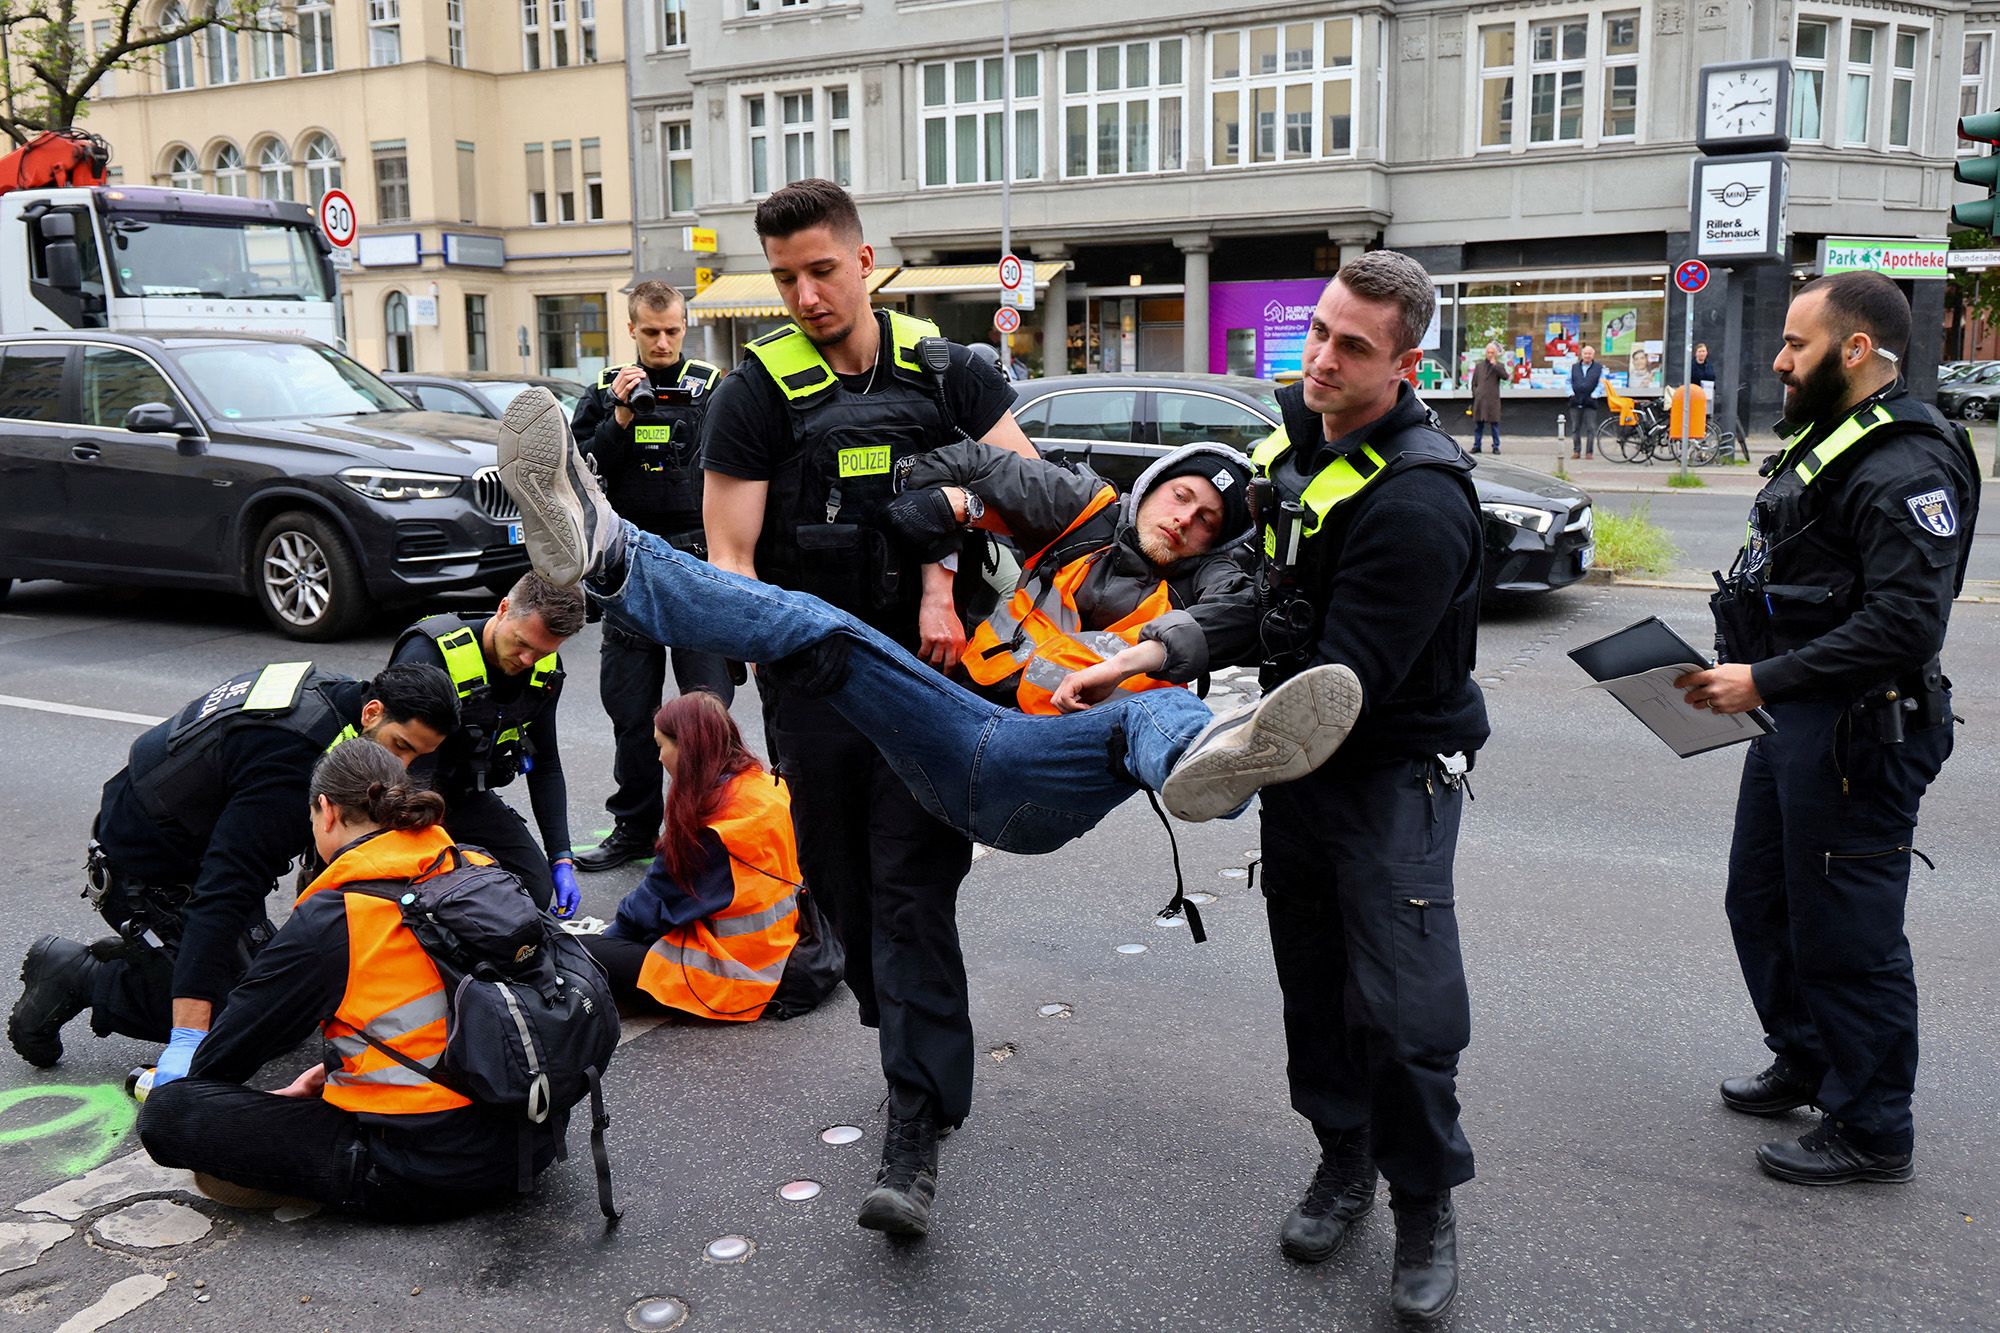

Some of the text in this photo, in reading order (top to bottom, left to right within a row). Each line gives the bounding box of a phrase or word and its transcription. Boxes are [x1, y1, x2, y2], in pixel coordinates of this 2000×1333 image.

[328, 205, 349, 232] 30
[1706, 218, 1742, 229] Riller &
[1706, 228, 1760, 239] Schnauck
[1828, 249, 1944, 269] Park Apotheke
[1004, 265, 1017, 280] 30
[1285, 312, 1309, 321] HOME
[636, 429, 668, 440] POLIZEI
[841, 451, 887, 472] POLIZEI
[896, 457, 917, 469] POLIZ
[1911, 492, 1945, 509] POLIZEI
[517, 527, 523, 541] B
[224, 680, 252, 700] BE
